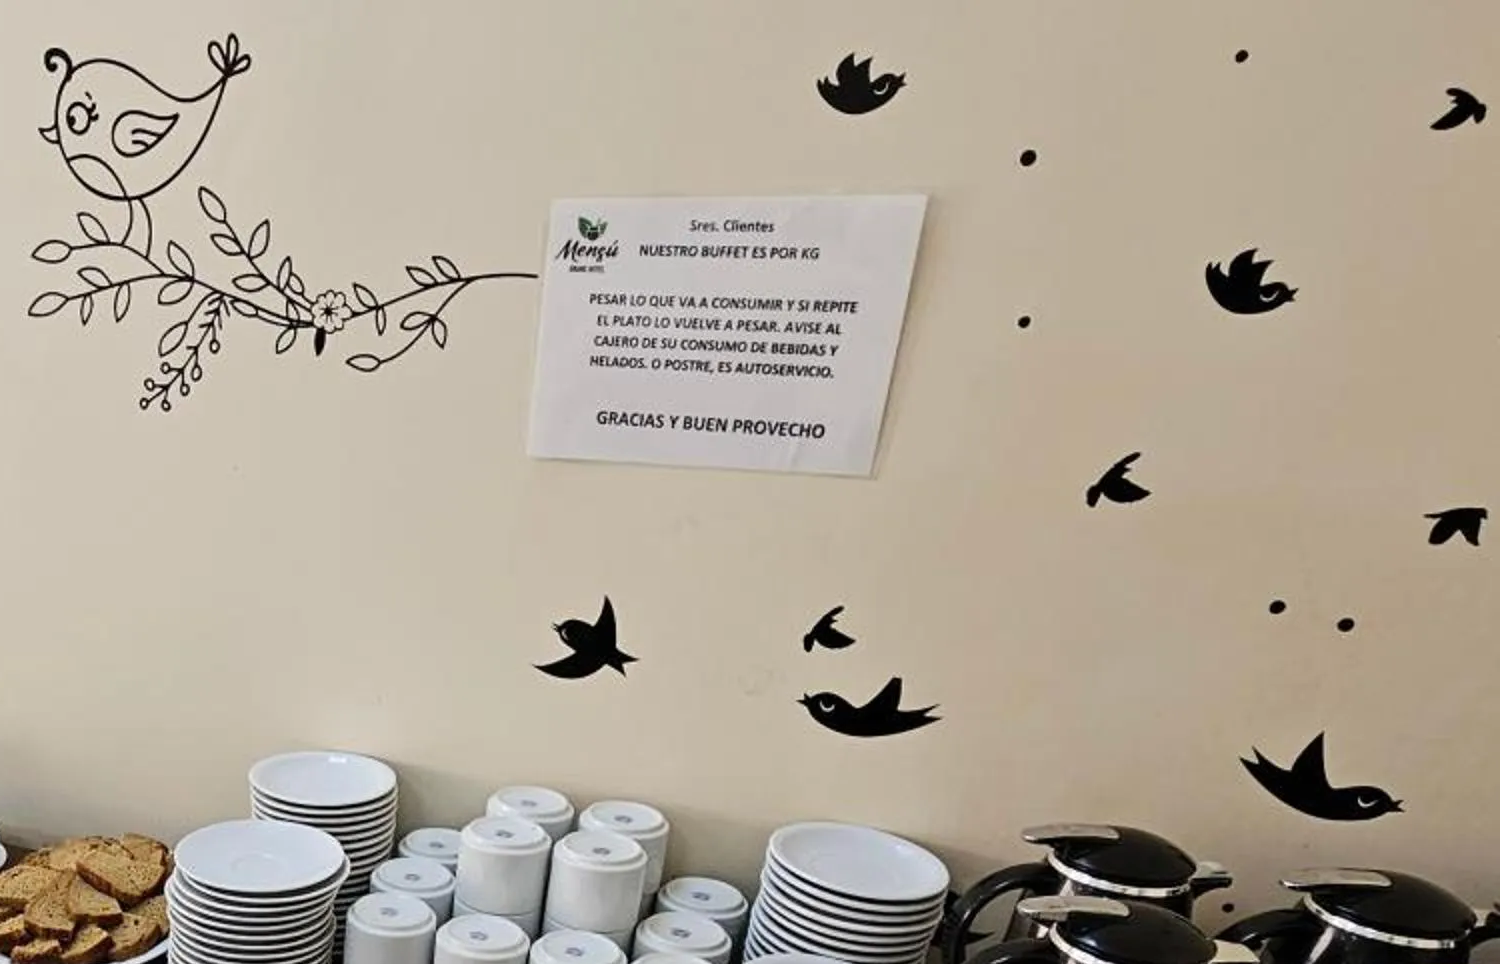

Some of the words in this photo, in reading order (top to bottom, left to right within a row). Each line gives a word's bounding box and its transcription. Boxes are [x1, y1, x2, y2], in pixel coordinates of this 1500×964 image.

[689, 219, 719, 232] Sres.
[723, 219, 775, 233] Clientes
[639, 245, 699, 258] NUESTRO
[701, 246, 748, 258] BUFFET
[751, 247, 767, 259] ES
[770, 247, 797, 260] POR
[801, 247, 820, 260] KG
[589, 293, 627, 306] PESAR
[630, 295, 646, 307] LO
[649, 295, 675, 308] QUE
[679, 296, 696, 308] VA
[698, 296, 709, 309] A
[711, 296, 783, 311] CONSUMIR
[787, 300, 795, 312] Y
[798, 300, 810, 313] SI
[813, 300, 859, 314] REPITE
[597, 315, 609, 327] EL
[614, 315, 652, 328] PLATO
[654, 317, 671, 329] LO
[674, 317, 720, 331] VUELVE
[723, 319, 733, 331] A
[736, 319, 780, 333] PESAR.
[784, 321, 822, 335] AVISE
[825, 323, 842, 335] AL
[593, 335, 639, 348] CAJERO
[641, 337, 658, 349] DE
[660, 338, 677, 349] SU
[681, 339, 748, 353] CONSUMO
[750, 341, 768, 354] DE
[771, 343, 827, 357] BEBIDAS
[830, 345, 840, 357] Y
[589, 355, 647, 369] HELADOS.
[651, 358, 661, 370] O
[664, 359, 714, 374] POSTRE,
[717, 361, 732, 373] ES
[735, 362, 834, 379] AUTOSERVICIO.
[596, 410, 665, 429] GRACIAS
[668, 415, 680, 429] Y
[683, 416, 729, 432] BUEN
[732, 419, 826, 439] PROVECHO
